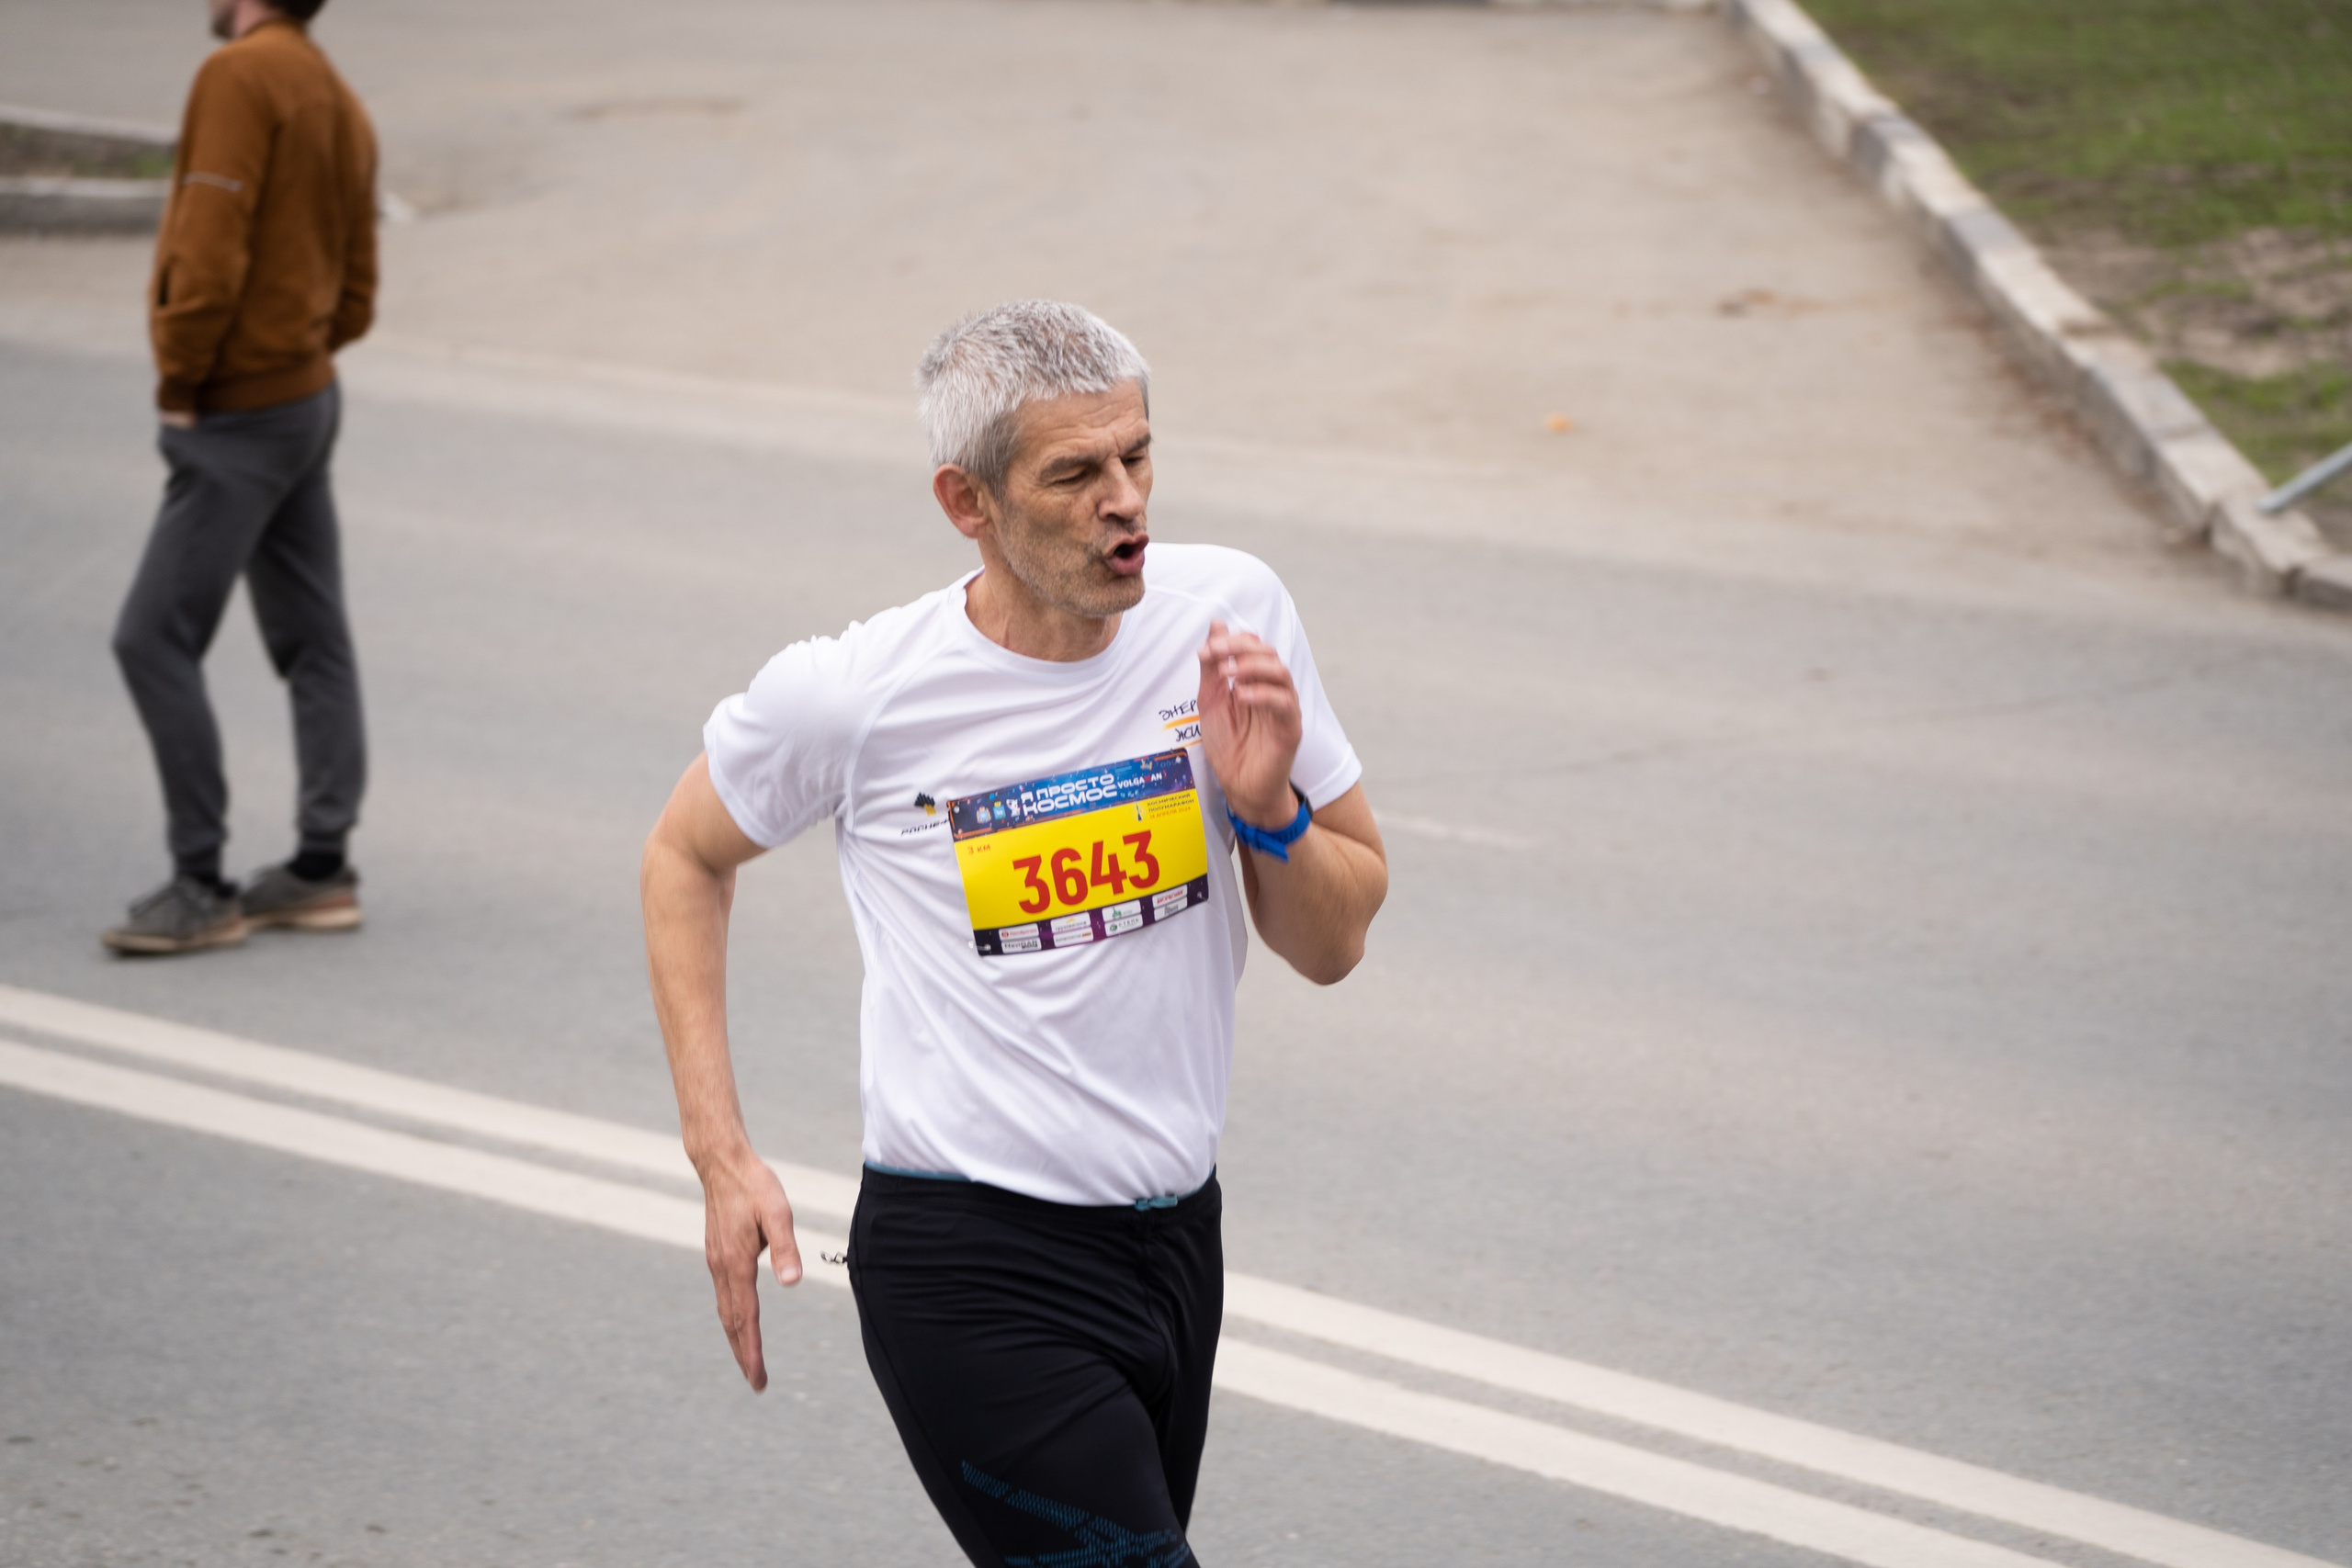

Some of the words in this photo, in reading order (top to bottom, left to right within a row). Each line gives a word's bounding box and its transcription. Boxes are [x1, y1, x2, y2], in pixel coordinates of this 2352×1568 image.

[1021, 791, 1035, 804] Я
[1036, 773, 1114, 800] ПРОСТО
[1023, 785, 1118, 817] КОСМОС
[967, 845, 975, 855] 3
[1012, 829, 1160, 915] 3643
